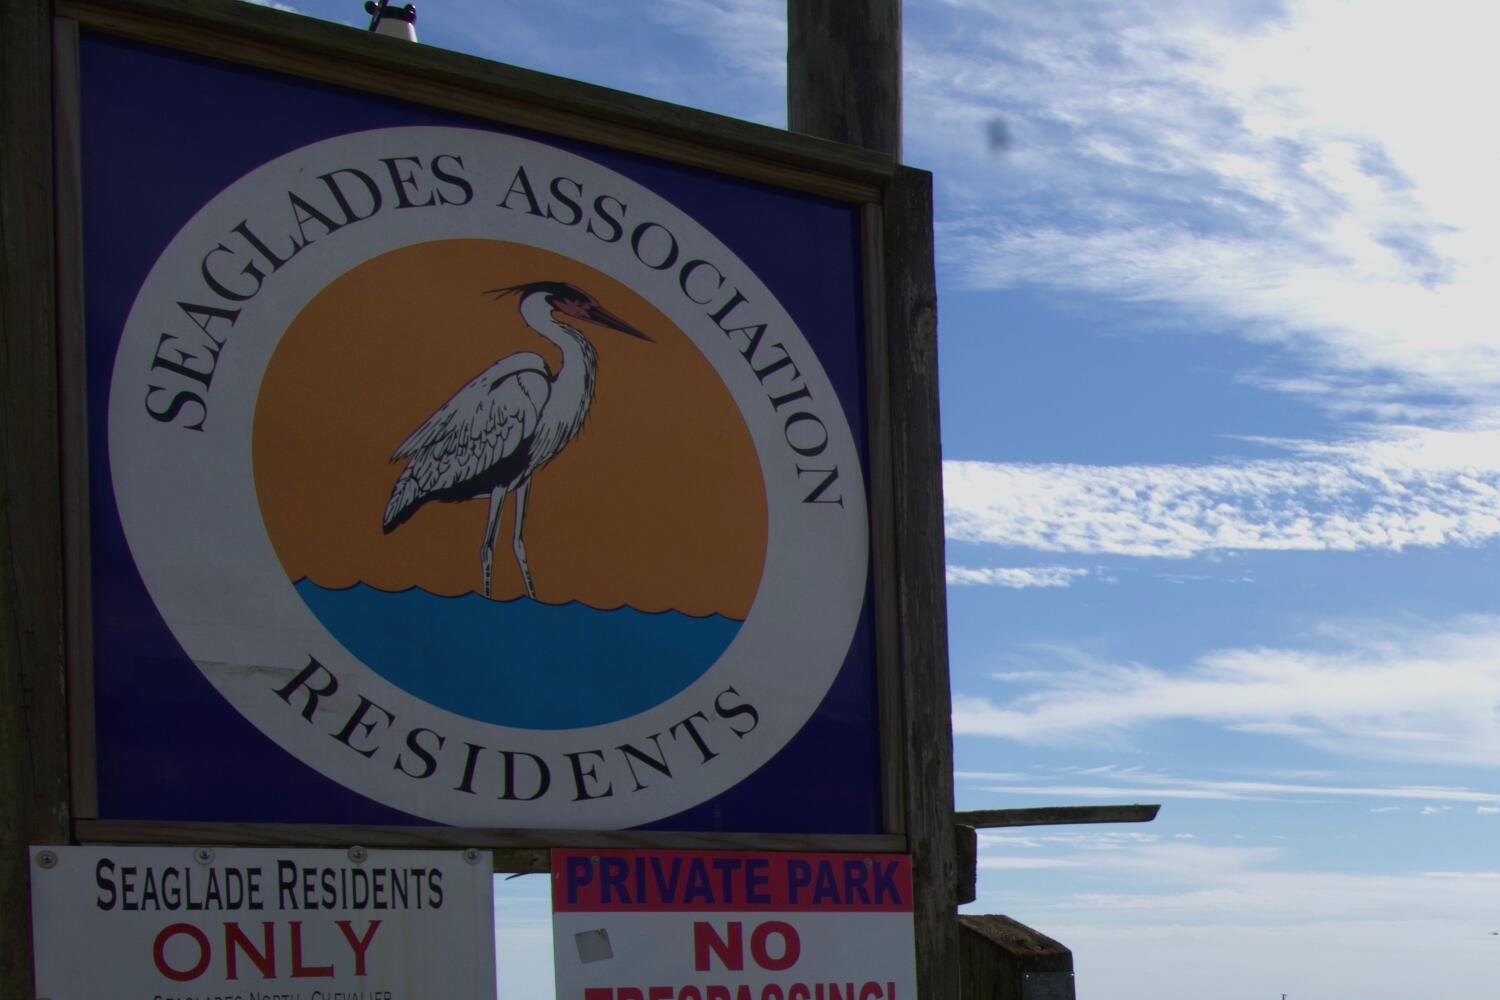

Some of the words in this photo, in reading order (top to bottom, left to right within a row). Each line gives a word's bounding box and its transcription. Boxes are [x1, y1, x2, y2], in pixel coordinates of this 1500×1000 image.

[145, 153, 475, 433] SEAGLADES
[497, 164, 846, 511] ASSOCIATION
[273, 653, 762, 804] RESIDENTS
[96, 857, 265, 911] SEAGLADE
[277, 858, 444, 910] RESIDENTS
[565, 856, 771, 906] PRIVATE
[787, 859, 903, 906] PARK
[153, 919, 382, 982] ONLY
[693, 920, 801, 972] NO
